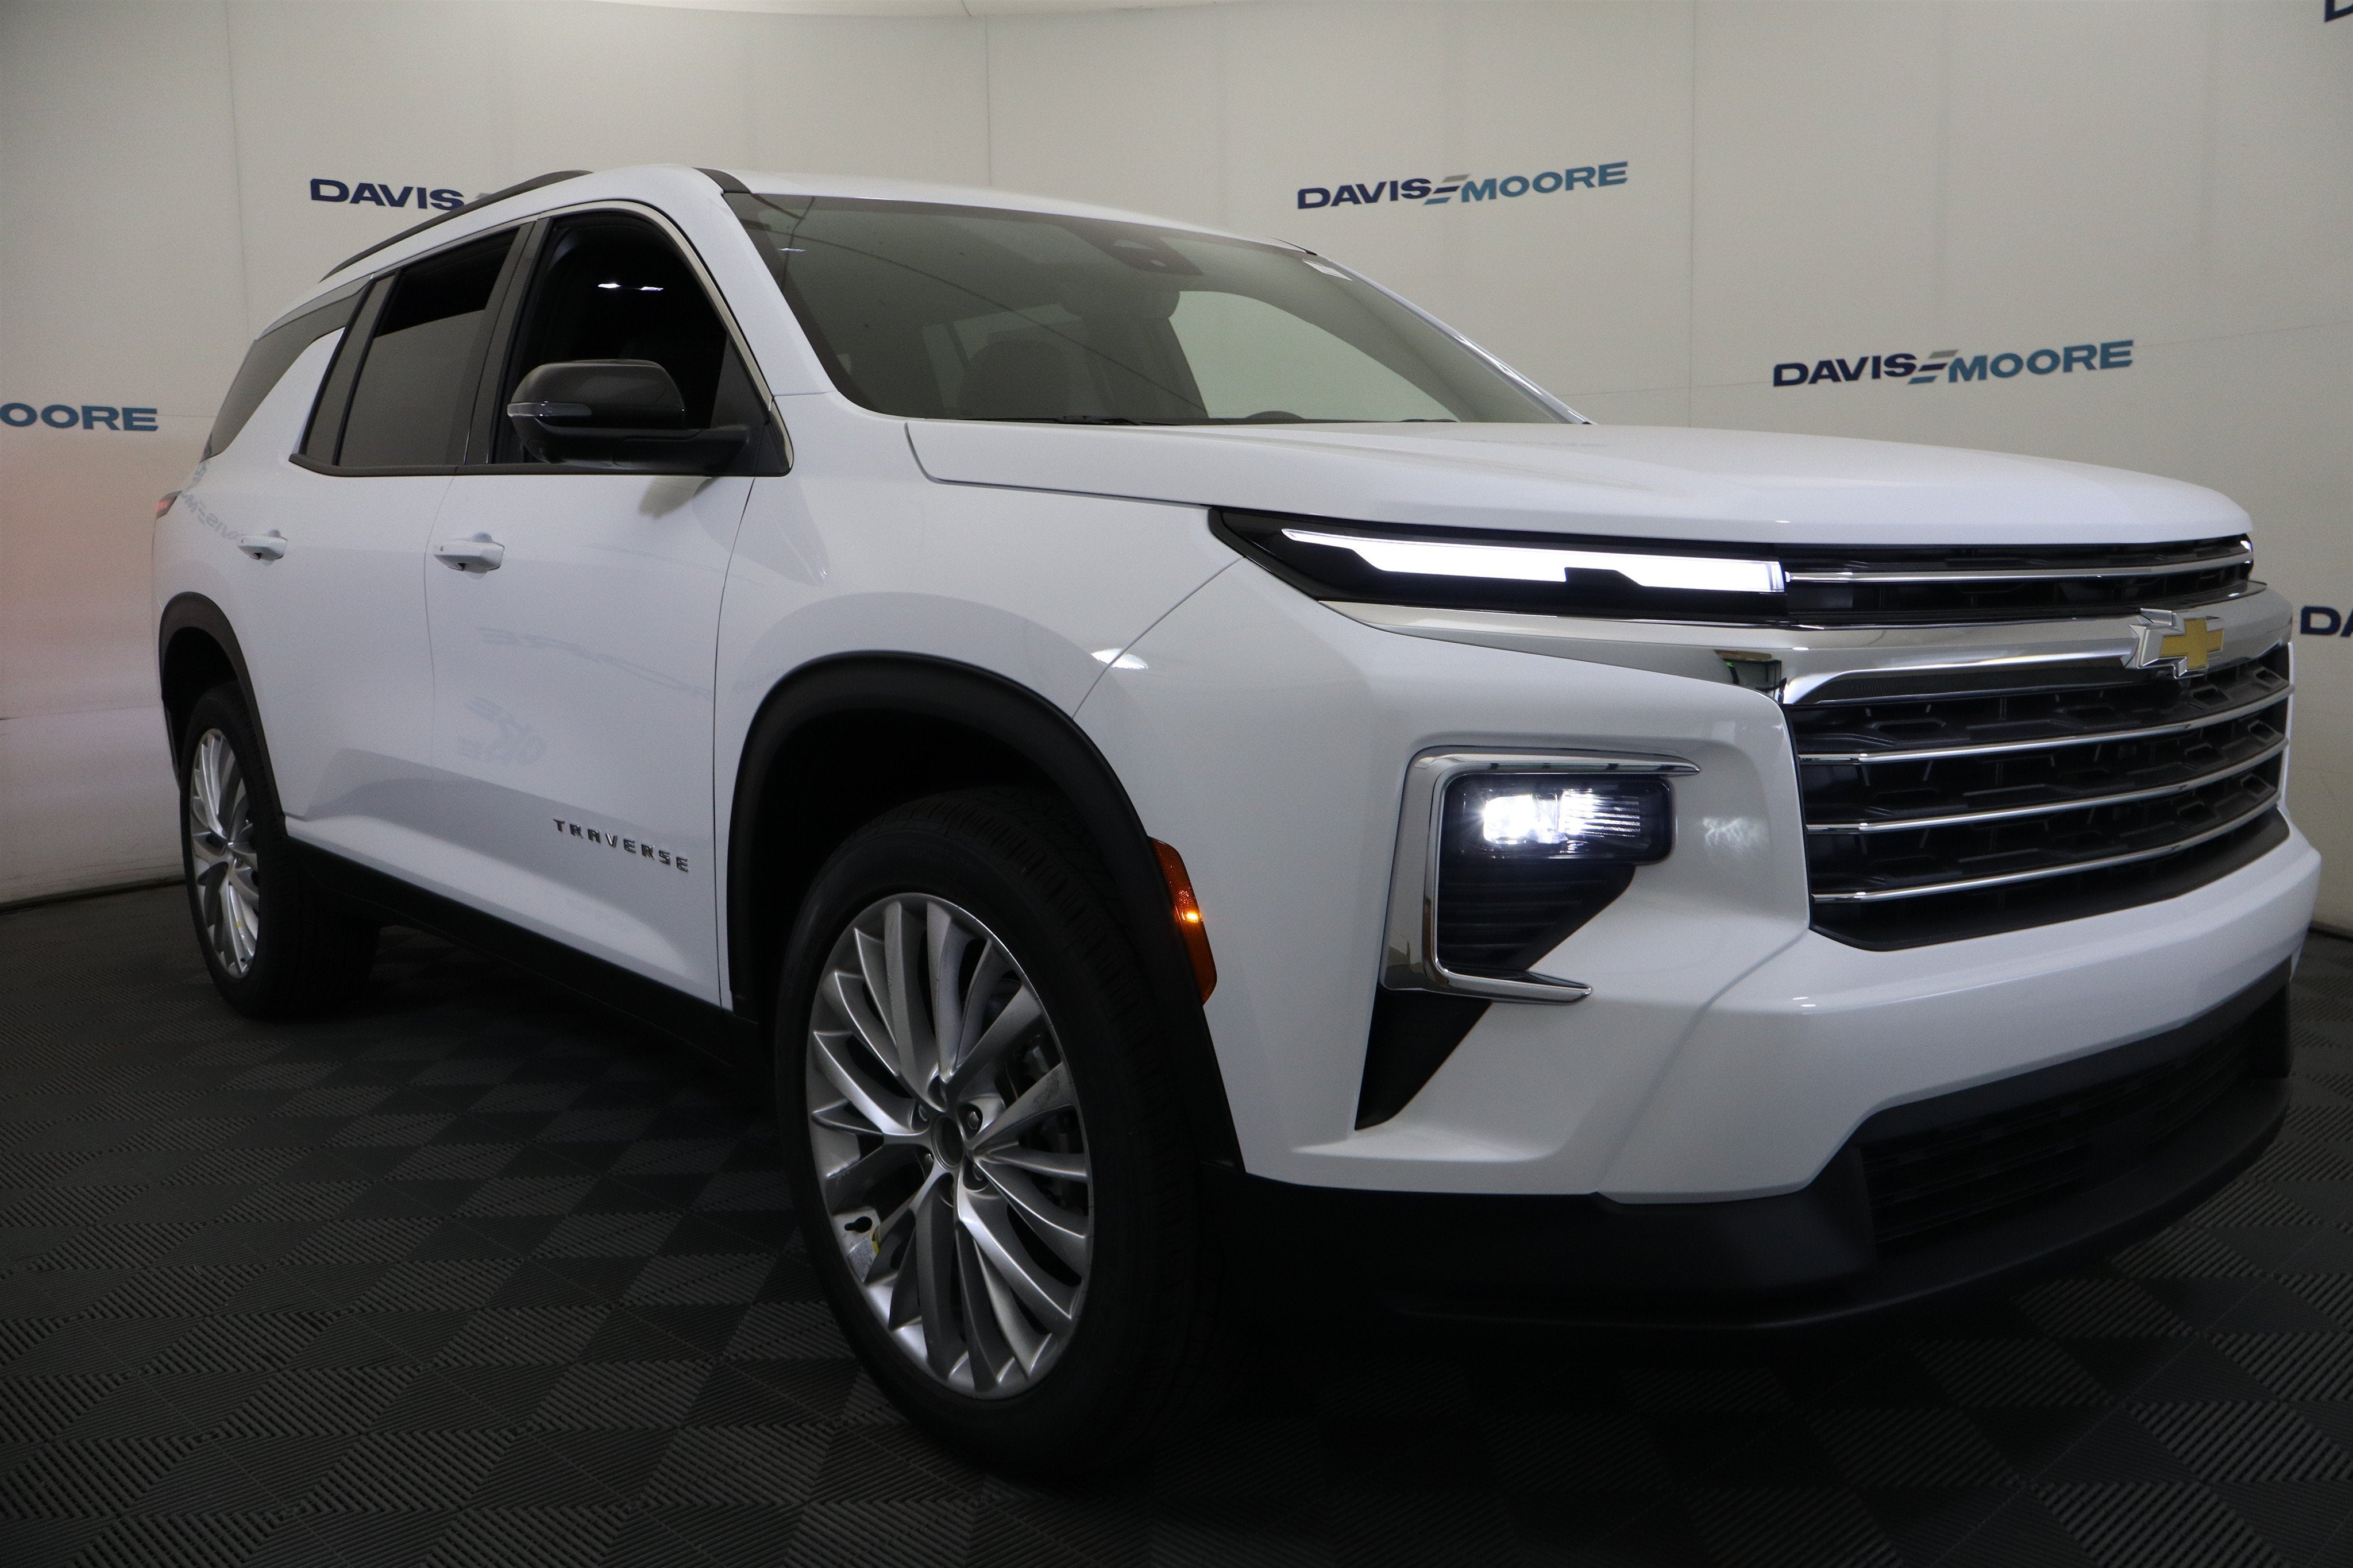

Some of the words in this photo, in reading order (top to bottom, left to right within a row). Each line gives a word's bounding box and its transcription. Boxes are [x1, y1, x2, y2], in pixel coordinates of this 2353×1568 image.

[310, 179, 464, 211] DAVIS
[1298, 179, 1432, 210] DAVIS
[1461, 161, 1628, 203] MOORE
[1774, 353, 1917, 387] DAVIS
[1949, 341, 2133, 383] MOORE
[2300, 606, 2353, 638] D
[553, 818, 689, 872] TRAVERSE
